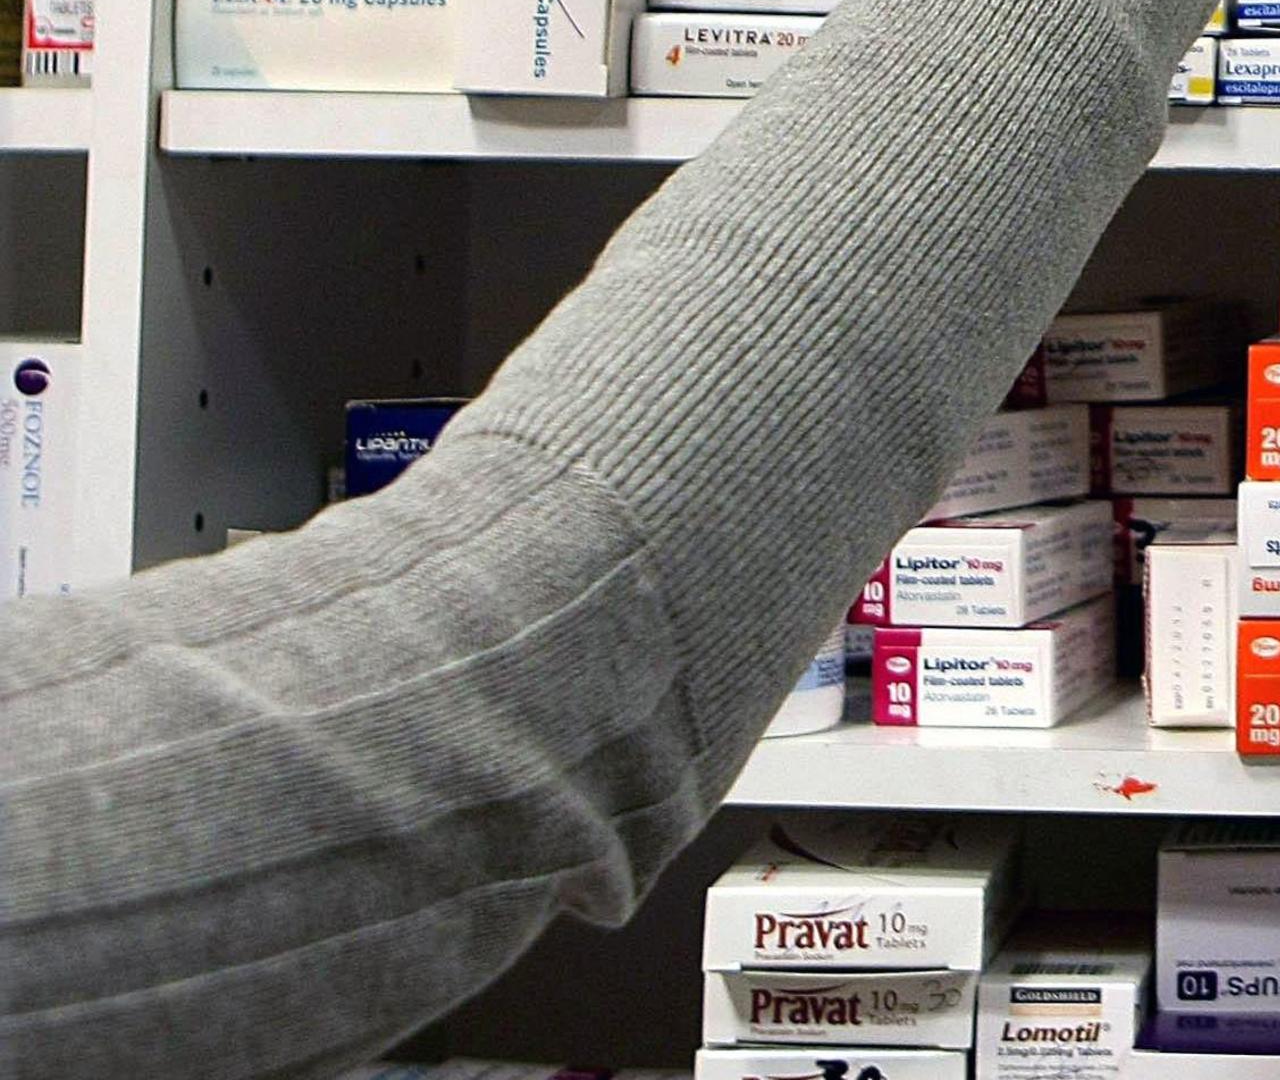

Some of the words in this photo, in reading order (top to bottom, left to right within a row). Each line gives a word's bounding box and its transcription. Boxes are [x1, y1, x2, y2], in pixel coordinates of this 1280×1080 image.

[923, 659, 990, 671] Lipitor
[754, 913, 868, 951] Pravat
[876, 912, 906, 934] 10
[1001, 1021, 1102, 1043] Lomotil
